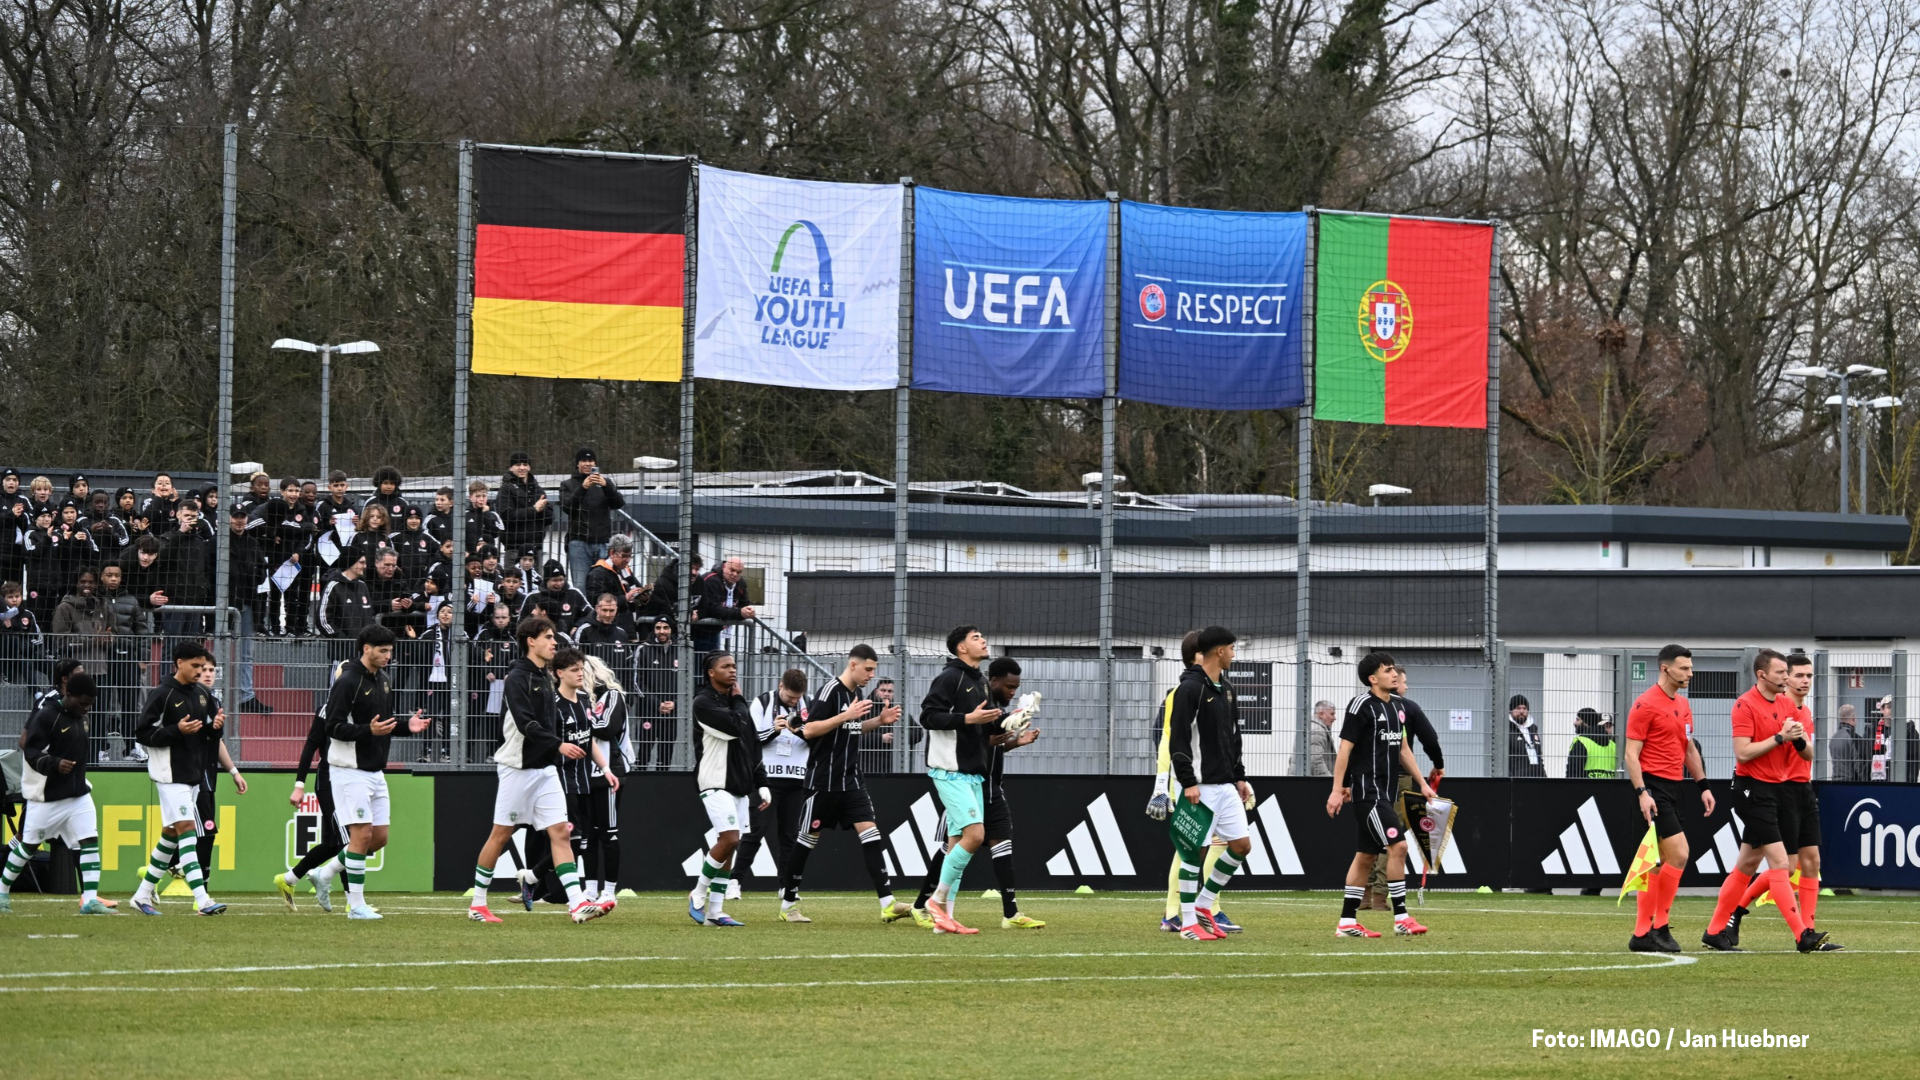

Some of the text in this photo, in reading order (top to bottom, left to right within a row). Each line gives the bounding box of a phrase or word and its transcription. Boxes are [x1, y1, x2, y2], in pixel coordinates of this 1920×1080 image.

[769, 275, 811, 297] UEFA
[944, 268, 1071, 325] UEFA
[754, 295, 845, 329] YOUTH
[1177, 292, 1286, 324] RESPECT
[761, 326, 830, 349] LEAGUE
[786, 765, 807, 776] MED
[1177, 815, 1192, 831] CLUBE
[1180, 808, 1203, 831] SPORTING
[1173, 820, 1198, 845] PORTUGAL
